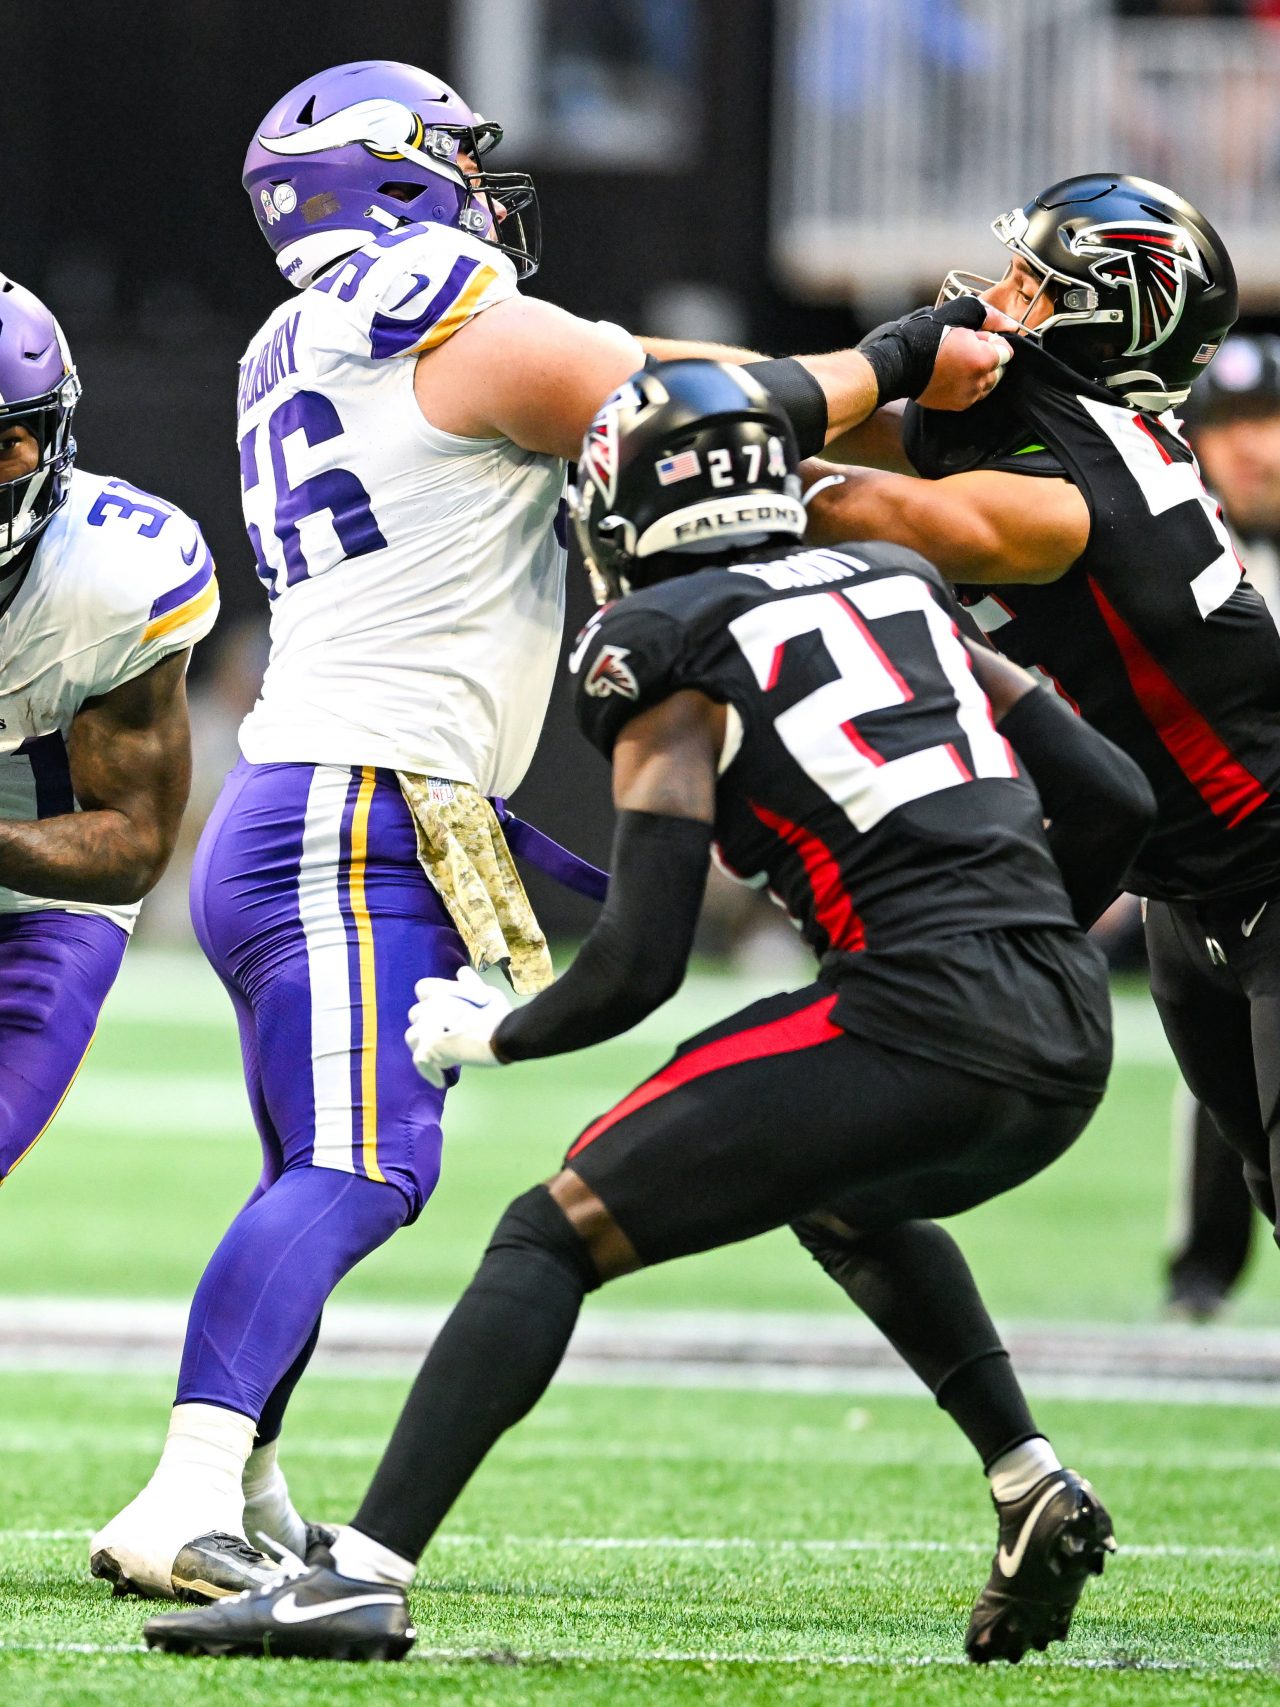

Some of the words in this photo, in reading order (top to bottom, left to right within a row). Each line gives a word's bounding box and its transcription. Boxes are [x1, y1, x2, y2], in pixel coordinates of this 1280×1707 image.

[706, 444, 762, 489] 27
[675, 506, 800, 543] FALCONS
[727, 574, 1020, 834] 27
